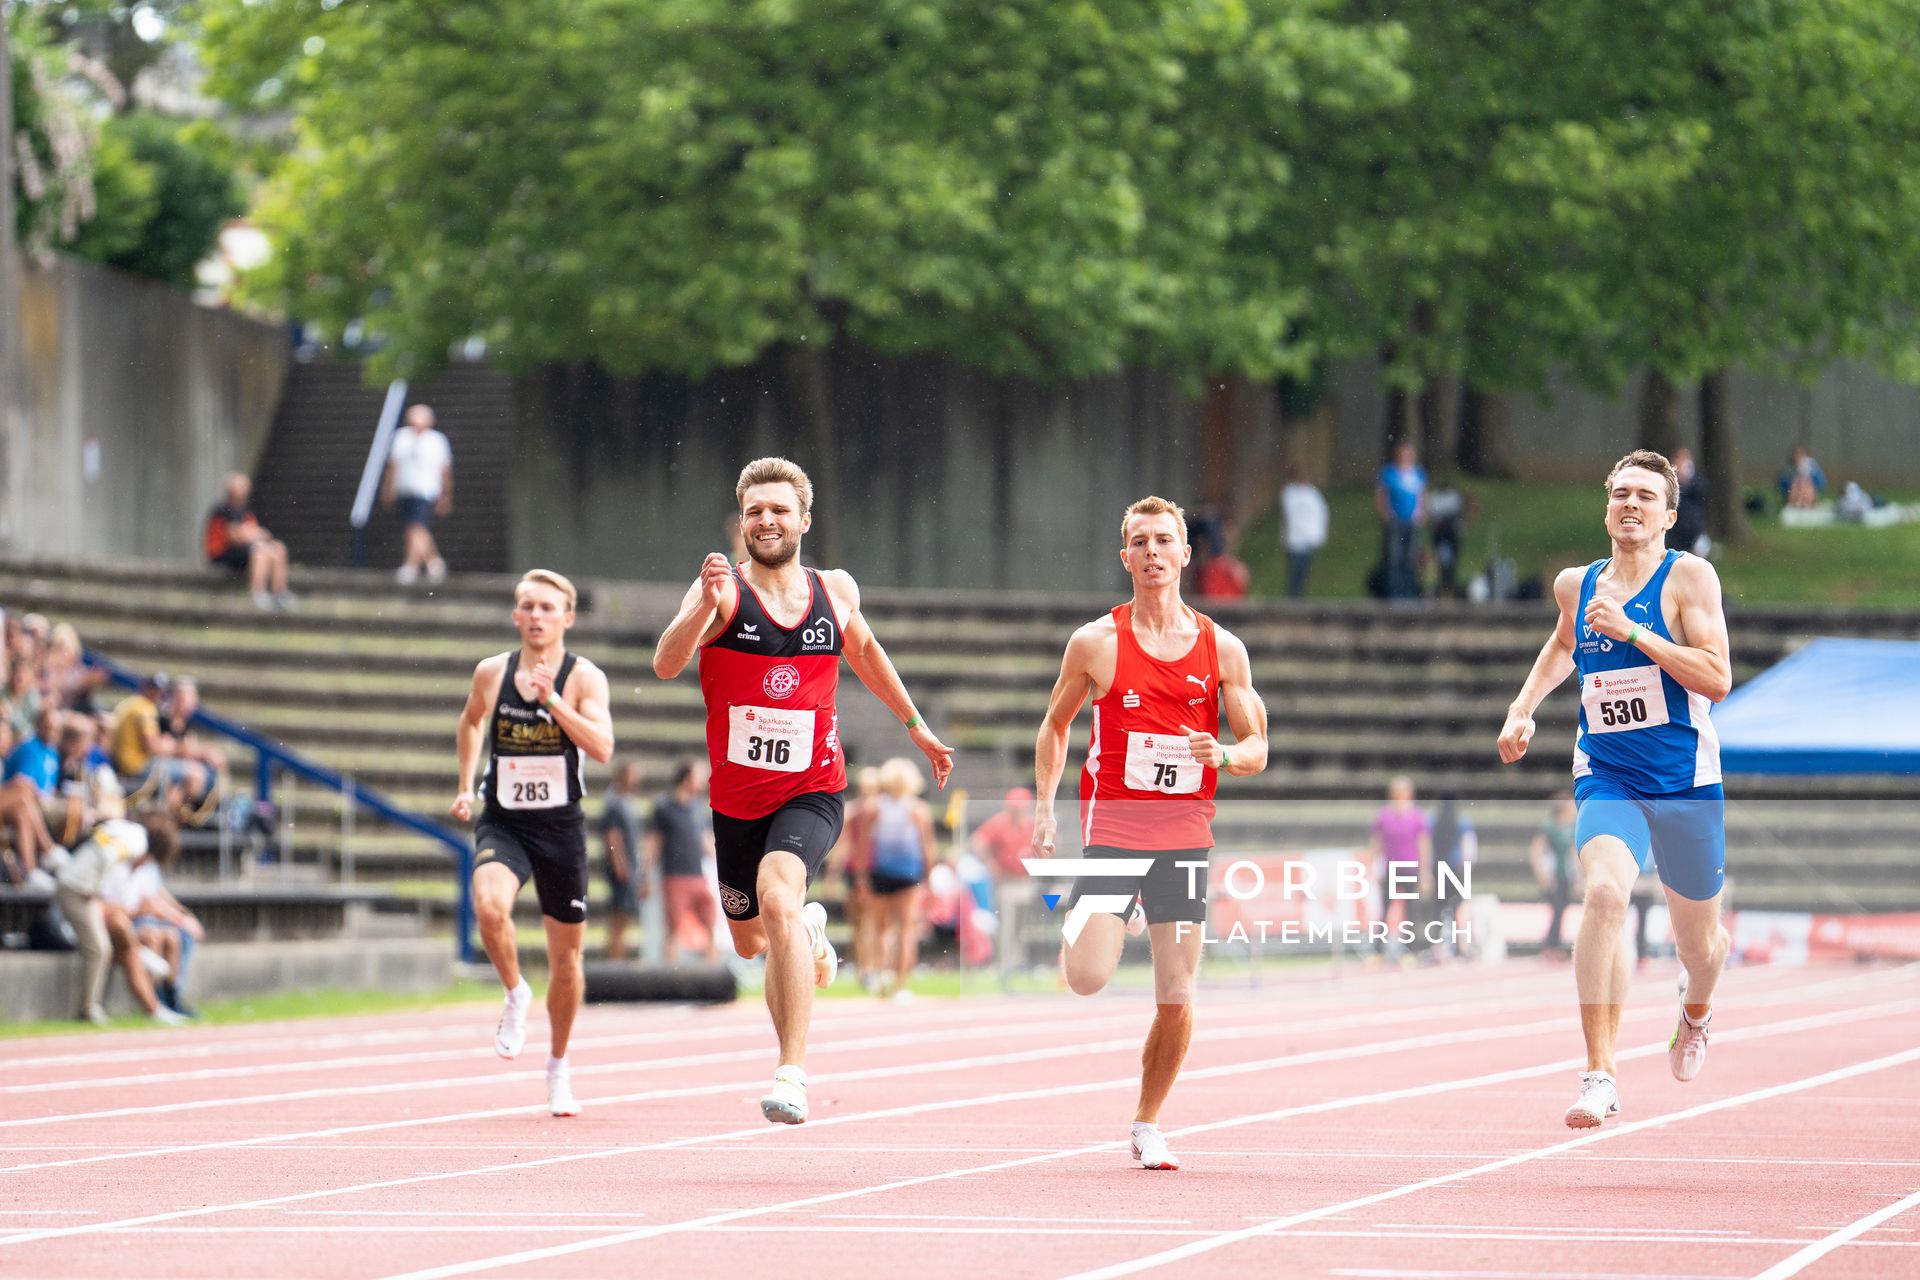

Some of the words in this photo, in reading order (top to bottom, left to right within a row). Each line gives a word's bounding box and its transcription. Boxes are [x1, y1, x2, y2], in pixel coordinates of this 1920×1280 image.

[737, 632, 761, 642] erima
[802, 628, 826, 644] OS
[1604, 677, 1639, 688] Sparkasse
[1606, 684, 1647, 696] Regensburg
[1600, 697, 1647, 726] 530
[758, 715, 793, 726] Sparkasse
[758, 724, 799, 736] Regensburg
[747, 735, 791, 765] 316
[1156, 743, 1188, 751] Sparkasse
[1156, 750, 1193, 760] Regensburg
[1153, 762, 1178, 788] 75
[513, 780, 549, 802] 283
